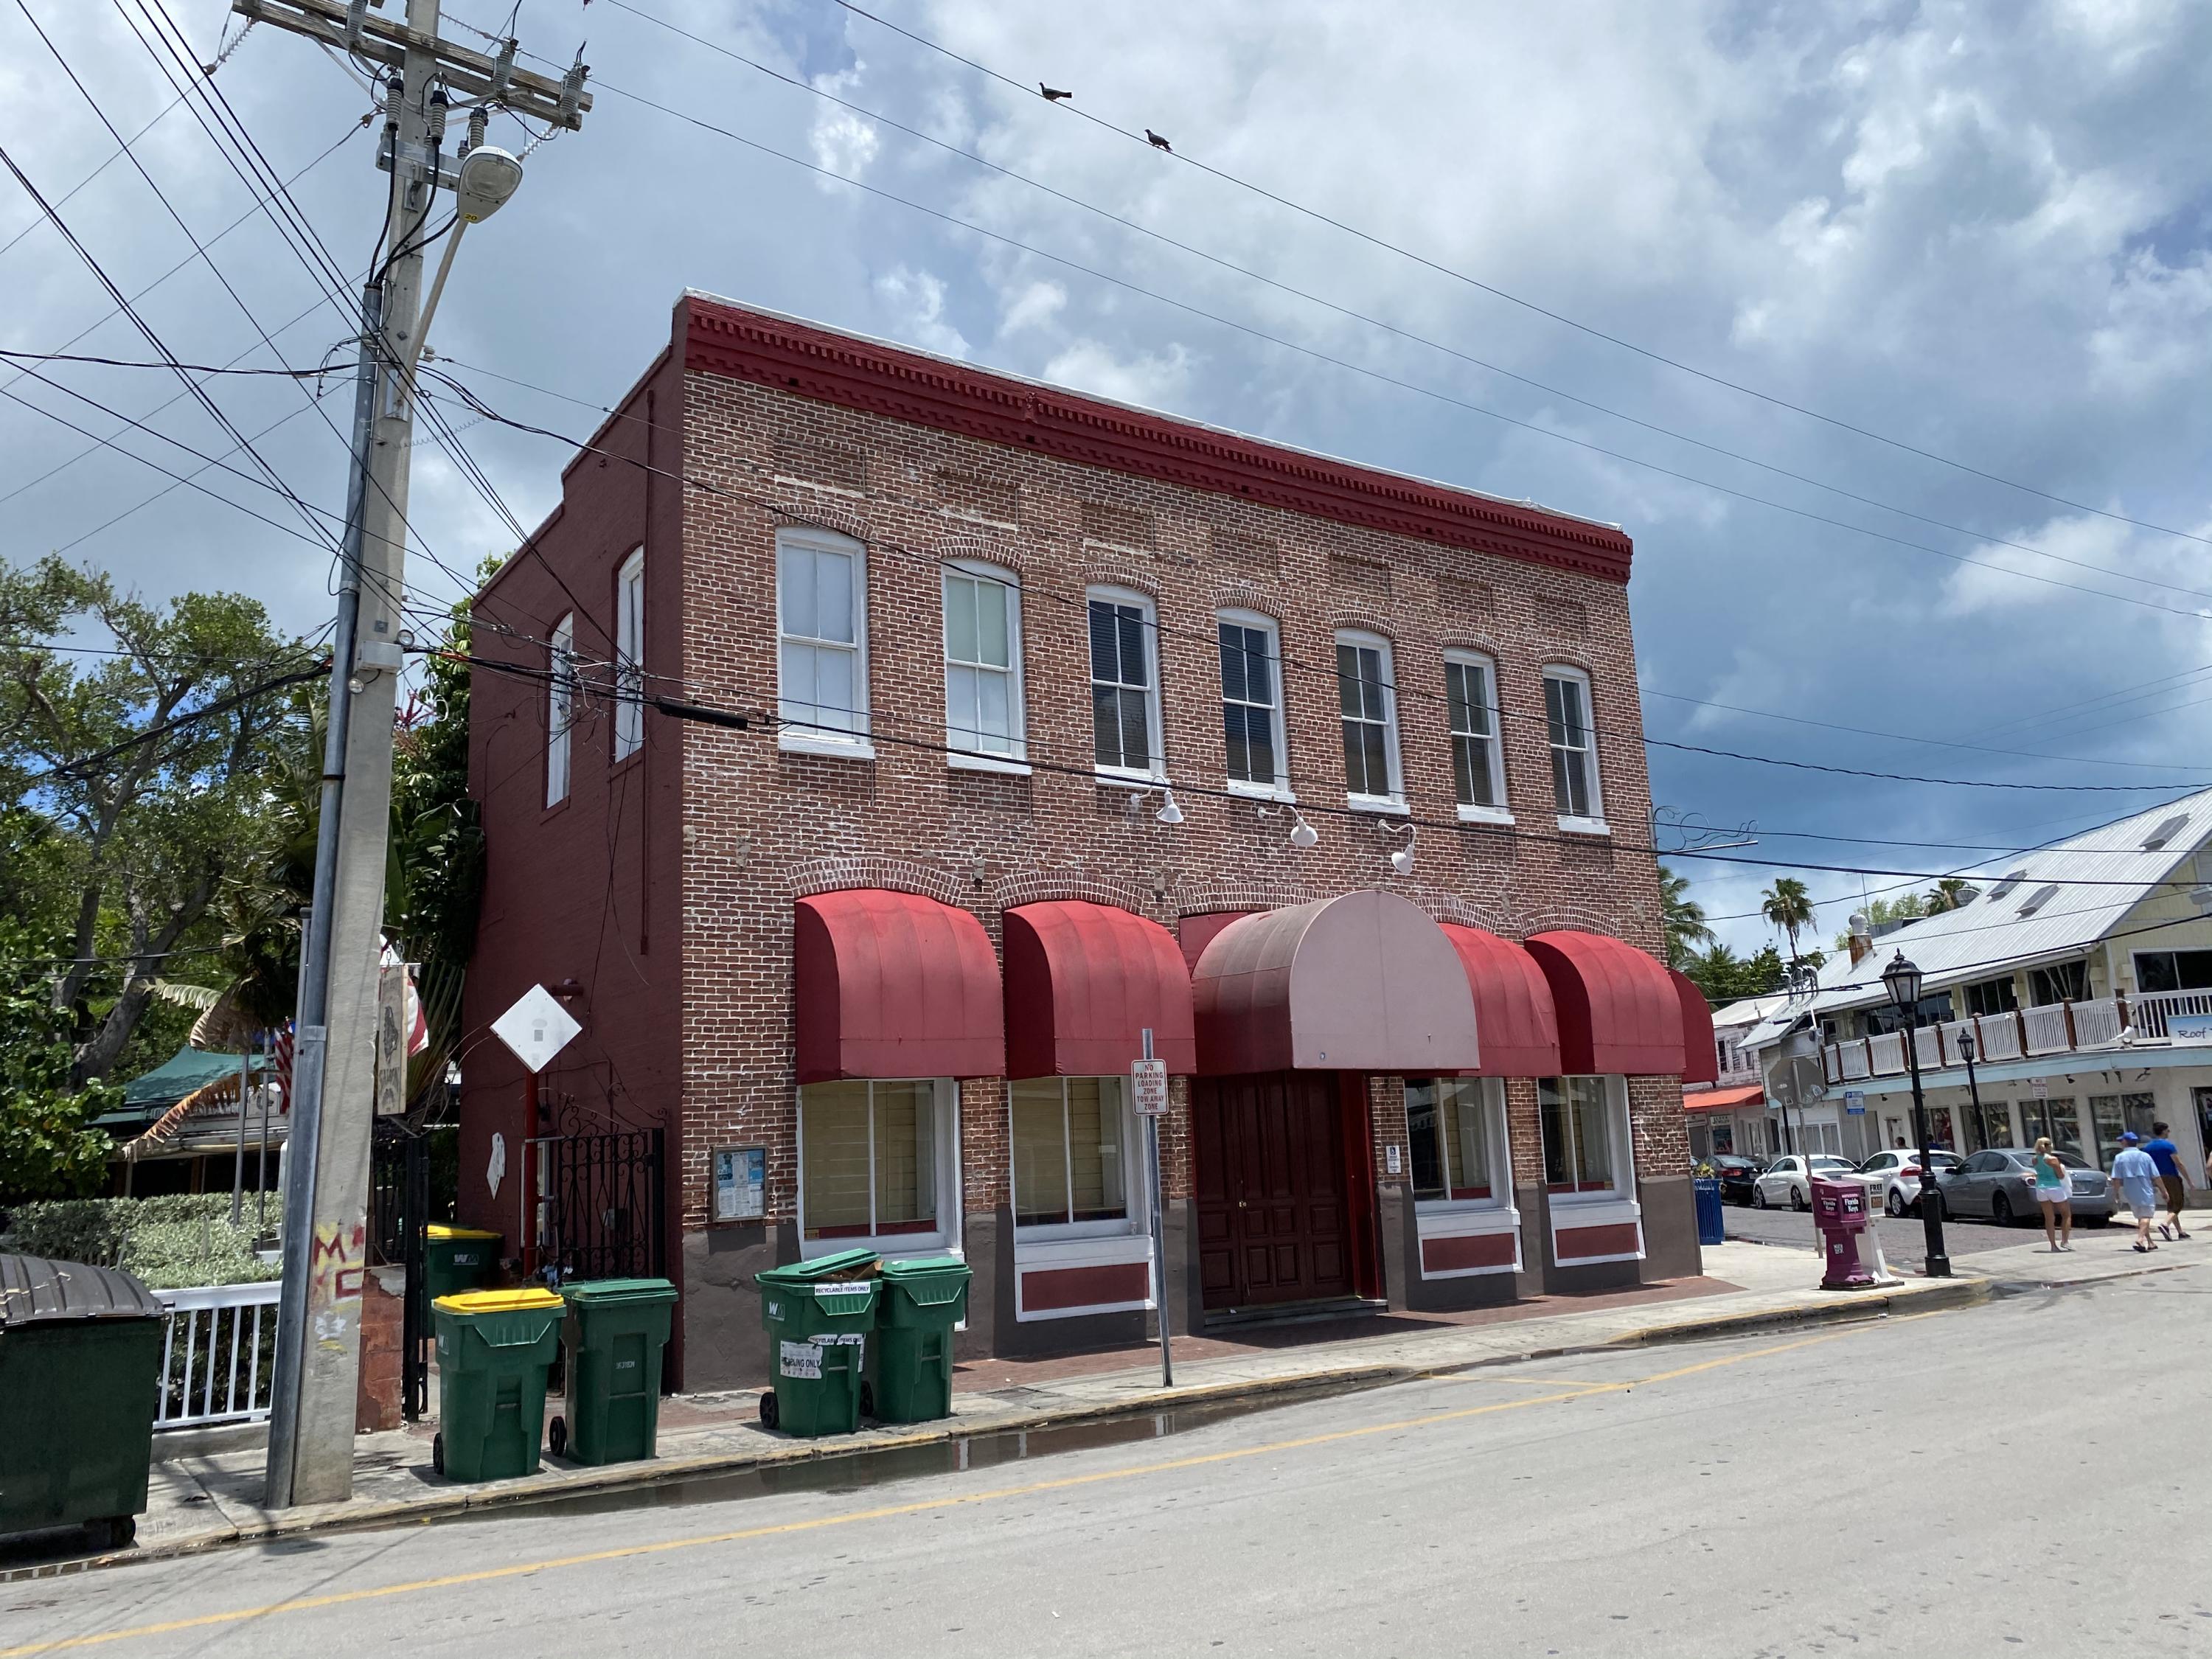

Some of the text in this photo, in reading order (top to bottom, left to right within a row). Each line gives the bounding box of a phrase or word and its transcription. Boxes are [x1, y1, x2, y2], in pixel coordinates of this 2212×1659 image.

[2177, 1027, 2206, 1039] Roof
[1870, 1183, 1882, 1192] FREE
[806, 1359, 820, 1368] ONLY
